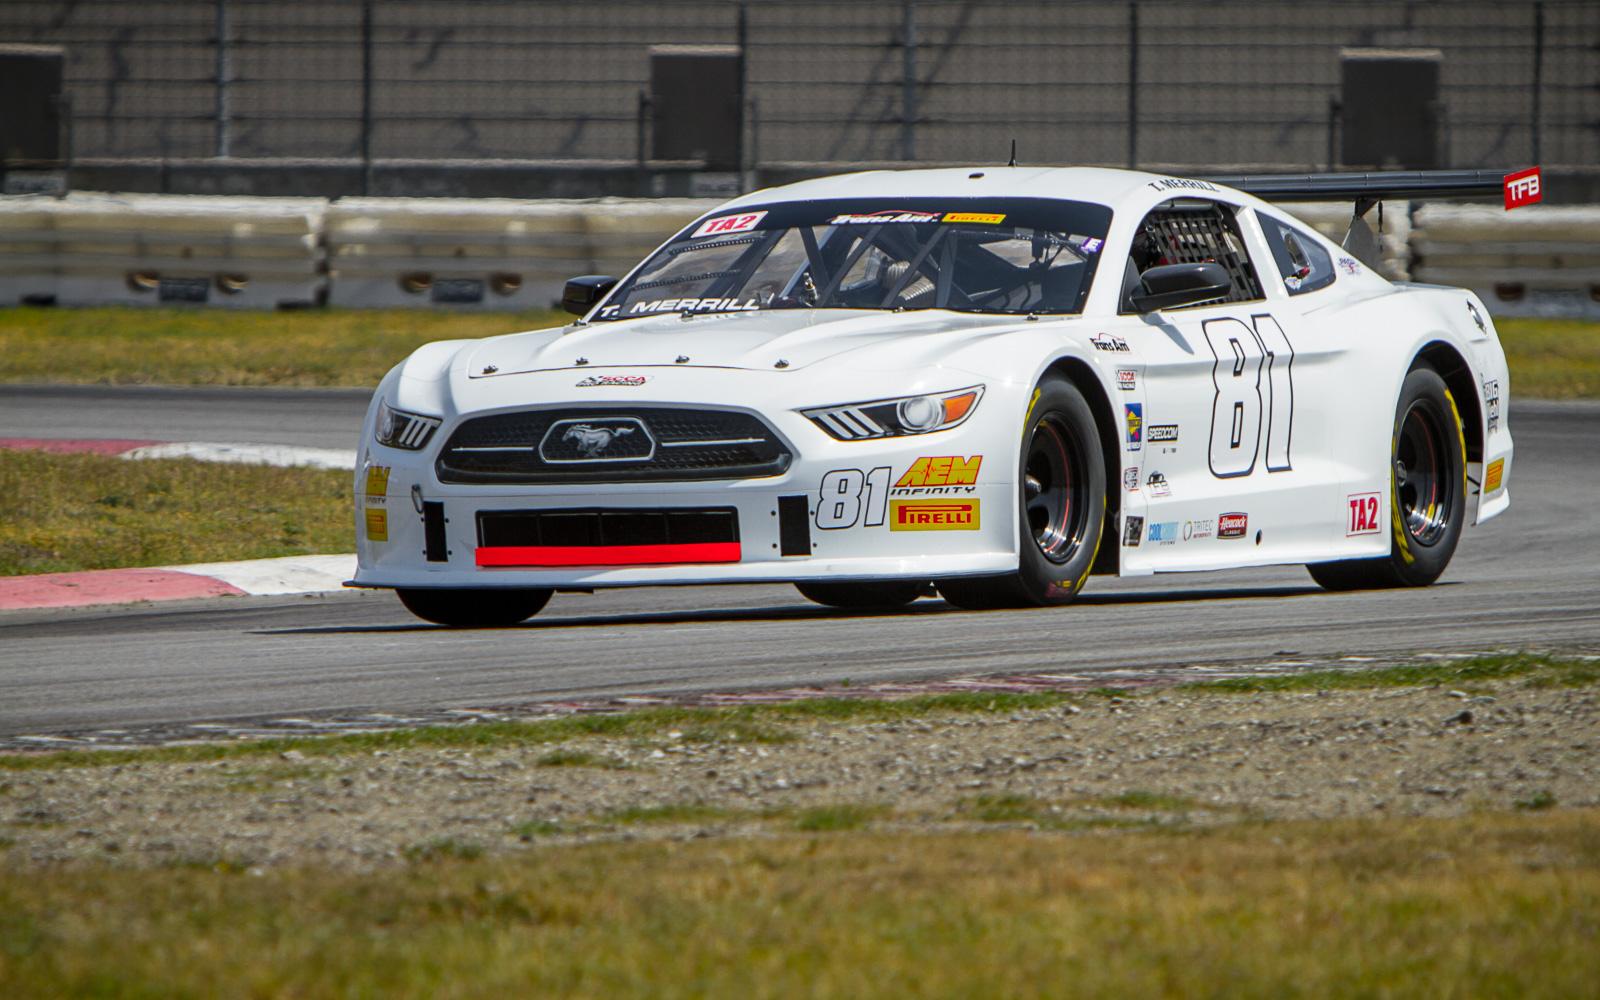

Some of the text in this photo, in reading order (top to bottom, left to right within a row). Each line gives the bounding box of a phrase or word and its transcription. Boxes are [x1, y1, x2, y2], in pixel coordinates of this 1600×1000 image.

[1507, 174, 1540, 200] TFB
[705, 215, 758, 233] TA2
[601, 298, 761, 318] T. MERRILL
[1089, 338, 1131, 352] Trans Am
[1201, 313, 1295, 479] 81
[893, 455, 984, 487] AEM
[815, 466, 892, 530] 81
[890, 486, 977, 496] INFINITY
[898, 504, 973, 524] PIRELLI
[1350, 497, 1377, 531] TA2
